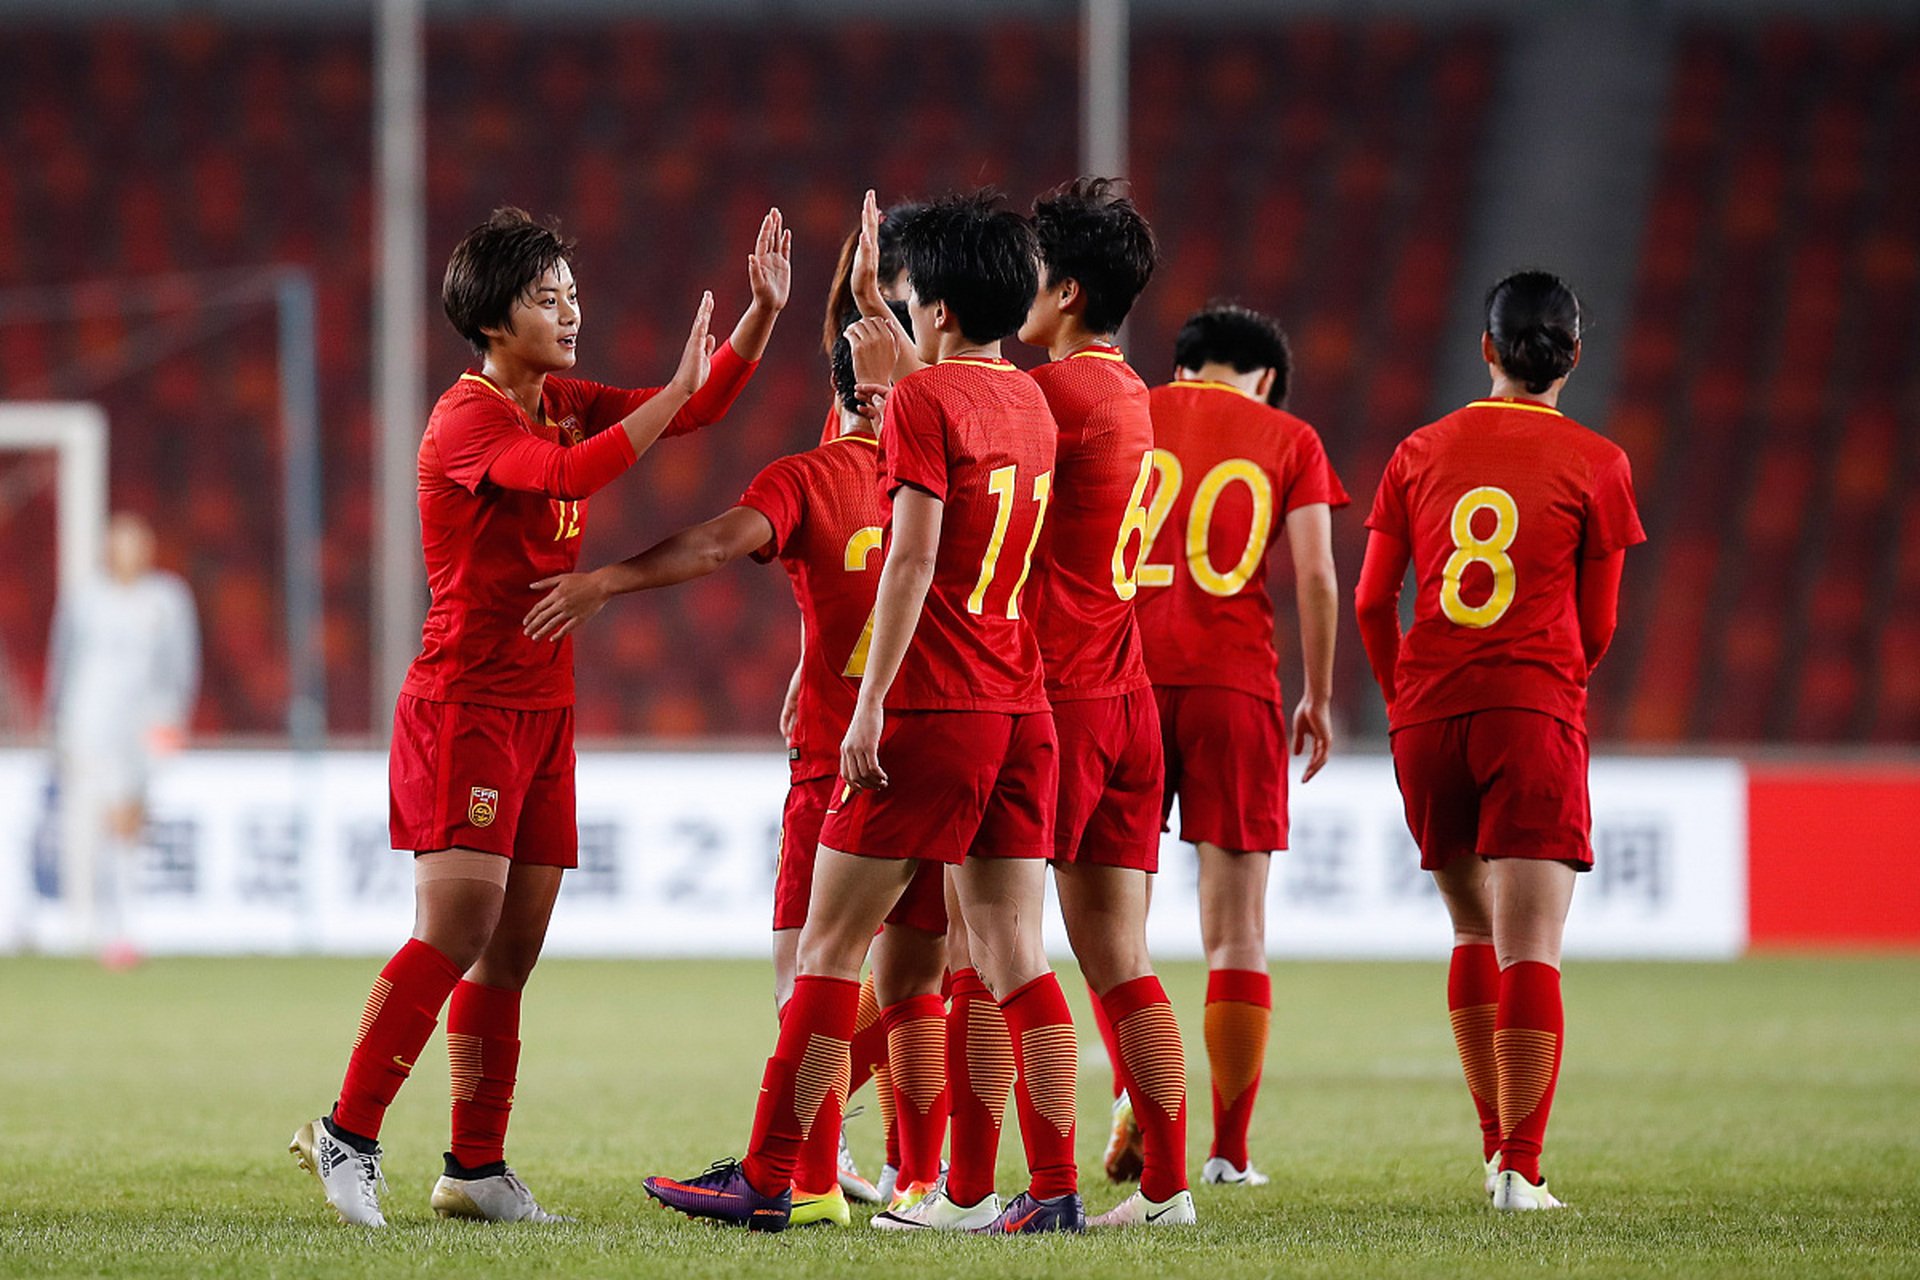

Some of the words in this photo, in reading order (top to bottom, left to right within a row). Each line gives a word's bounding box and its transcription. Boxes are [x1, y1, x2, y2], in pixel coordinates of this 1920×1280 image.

[967, 464, 1051, 620] 11
[1112, 451, 1153, 601] 6
[1137, 448, 1272, 597] 20
[1440, 486, 1519, 629] 8
